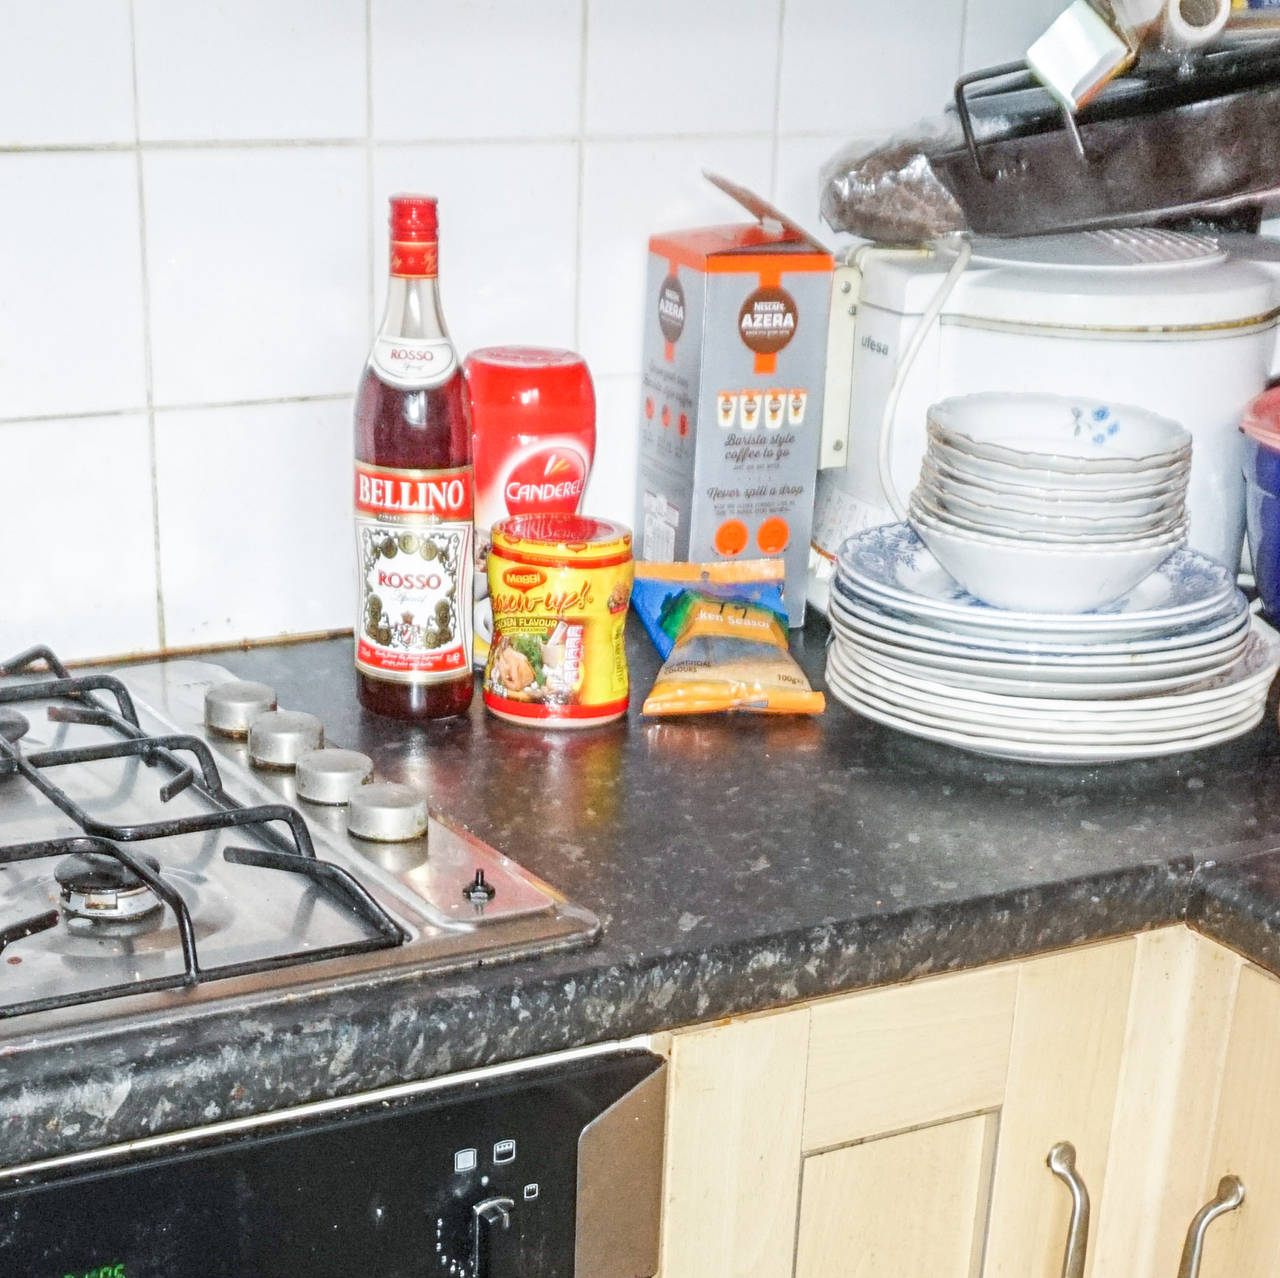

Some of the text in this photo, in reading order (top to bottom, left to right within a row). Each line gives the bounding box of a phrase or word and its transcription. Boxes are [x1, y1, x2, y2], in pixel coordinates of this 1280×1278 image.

[659, 298, 684, 321] AZERA
[741, 313, 795, 329] AZERA
[391, 349, 434, 361] ROSSO
[724, 432, 796, 447] Barista style
[725, 447, 760, 463] coffee
[359, 473, 465, 511] BELLINO
[506, 479, 582, 500] CANDEREL
[378, 570, 442, 590] ROSSO
[506, 573, 540, 584] Maggi
[519, 617, 558, 628] FLAVOUR
